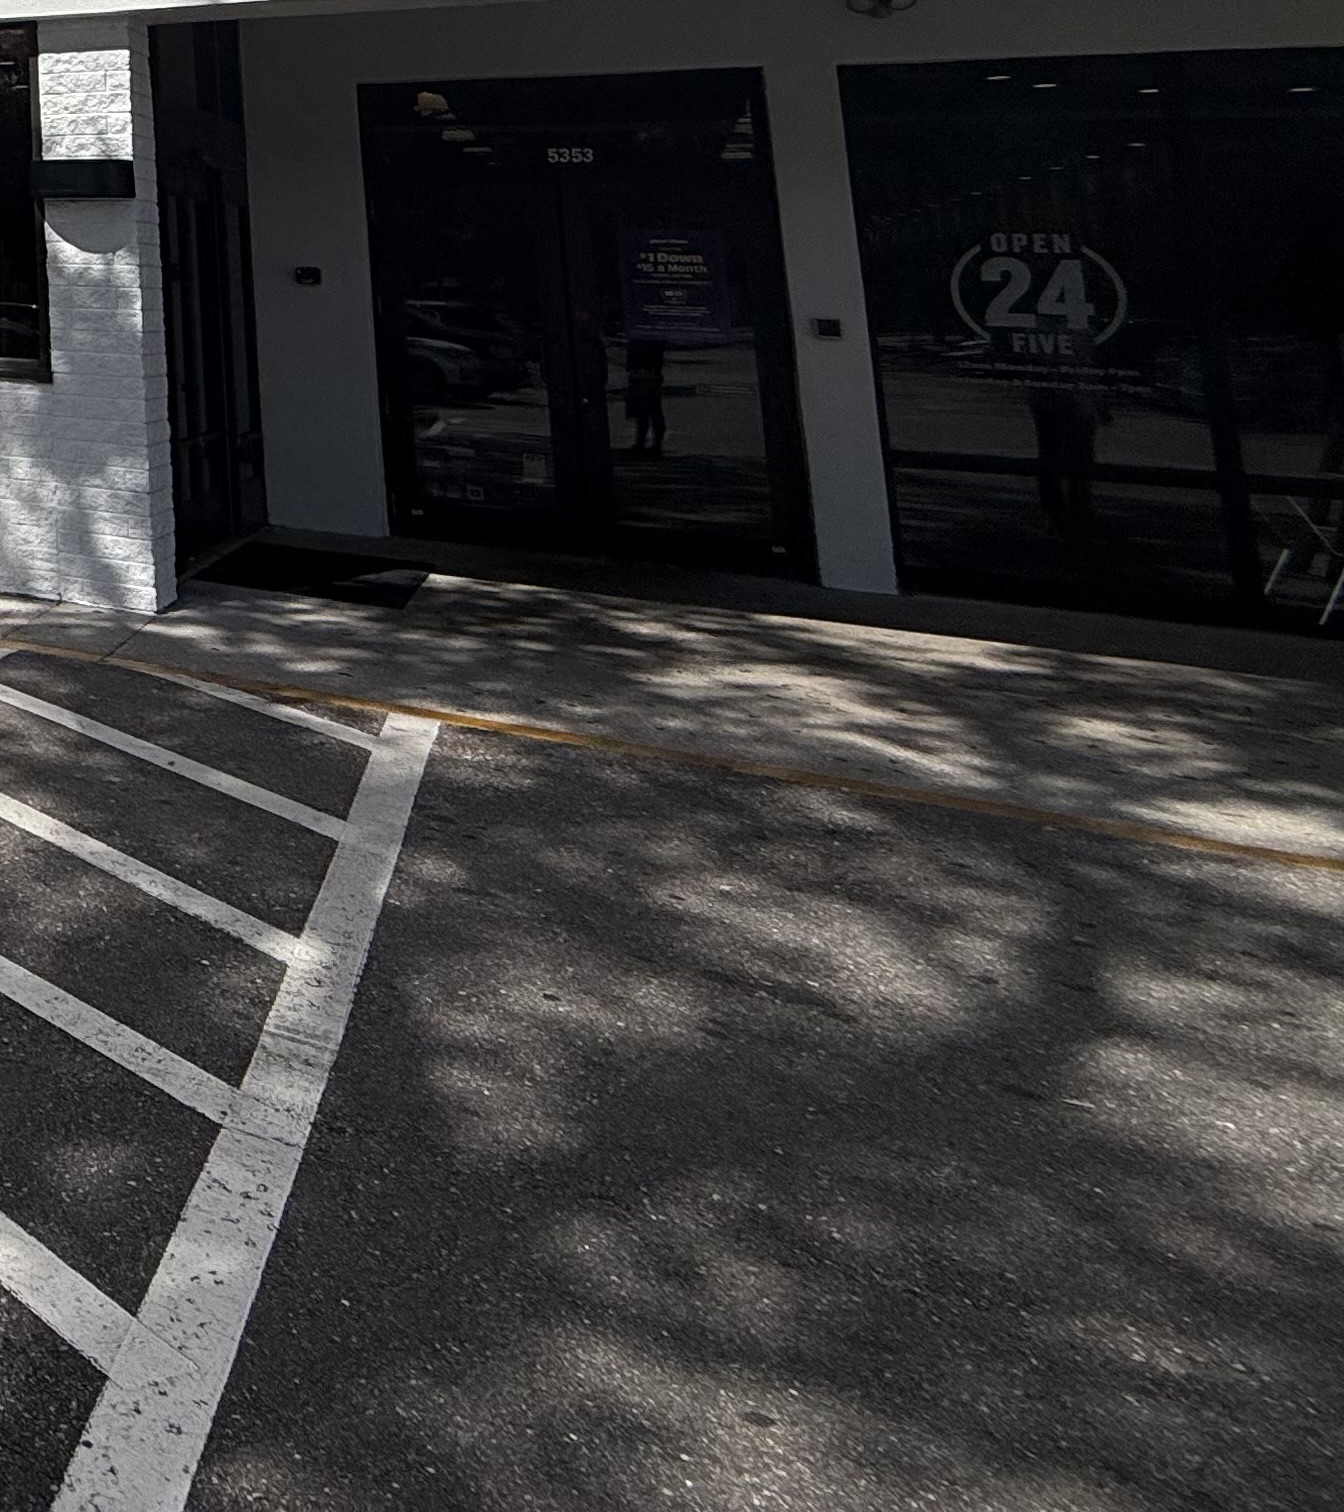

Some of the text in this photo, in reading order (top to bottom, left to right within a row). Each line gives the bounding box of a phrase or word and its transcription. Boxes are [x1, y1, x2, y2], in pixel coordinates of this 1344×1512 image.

[547, 147, 594, 163] 5353
[989, 232, 1072, 254] OPEN
[656, 252, 704, 263] Down
[657, 264, 666, 272] a
[667, 264, 708, 274] Month
[980, 255, 1095, 329] 24
[1011, 331, 1074, 355] FIVE
